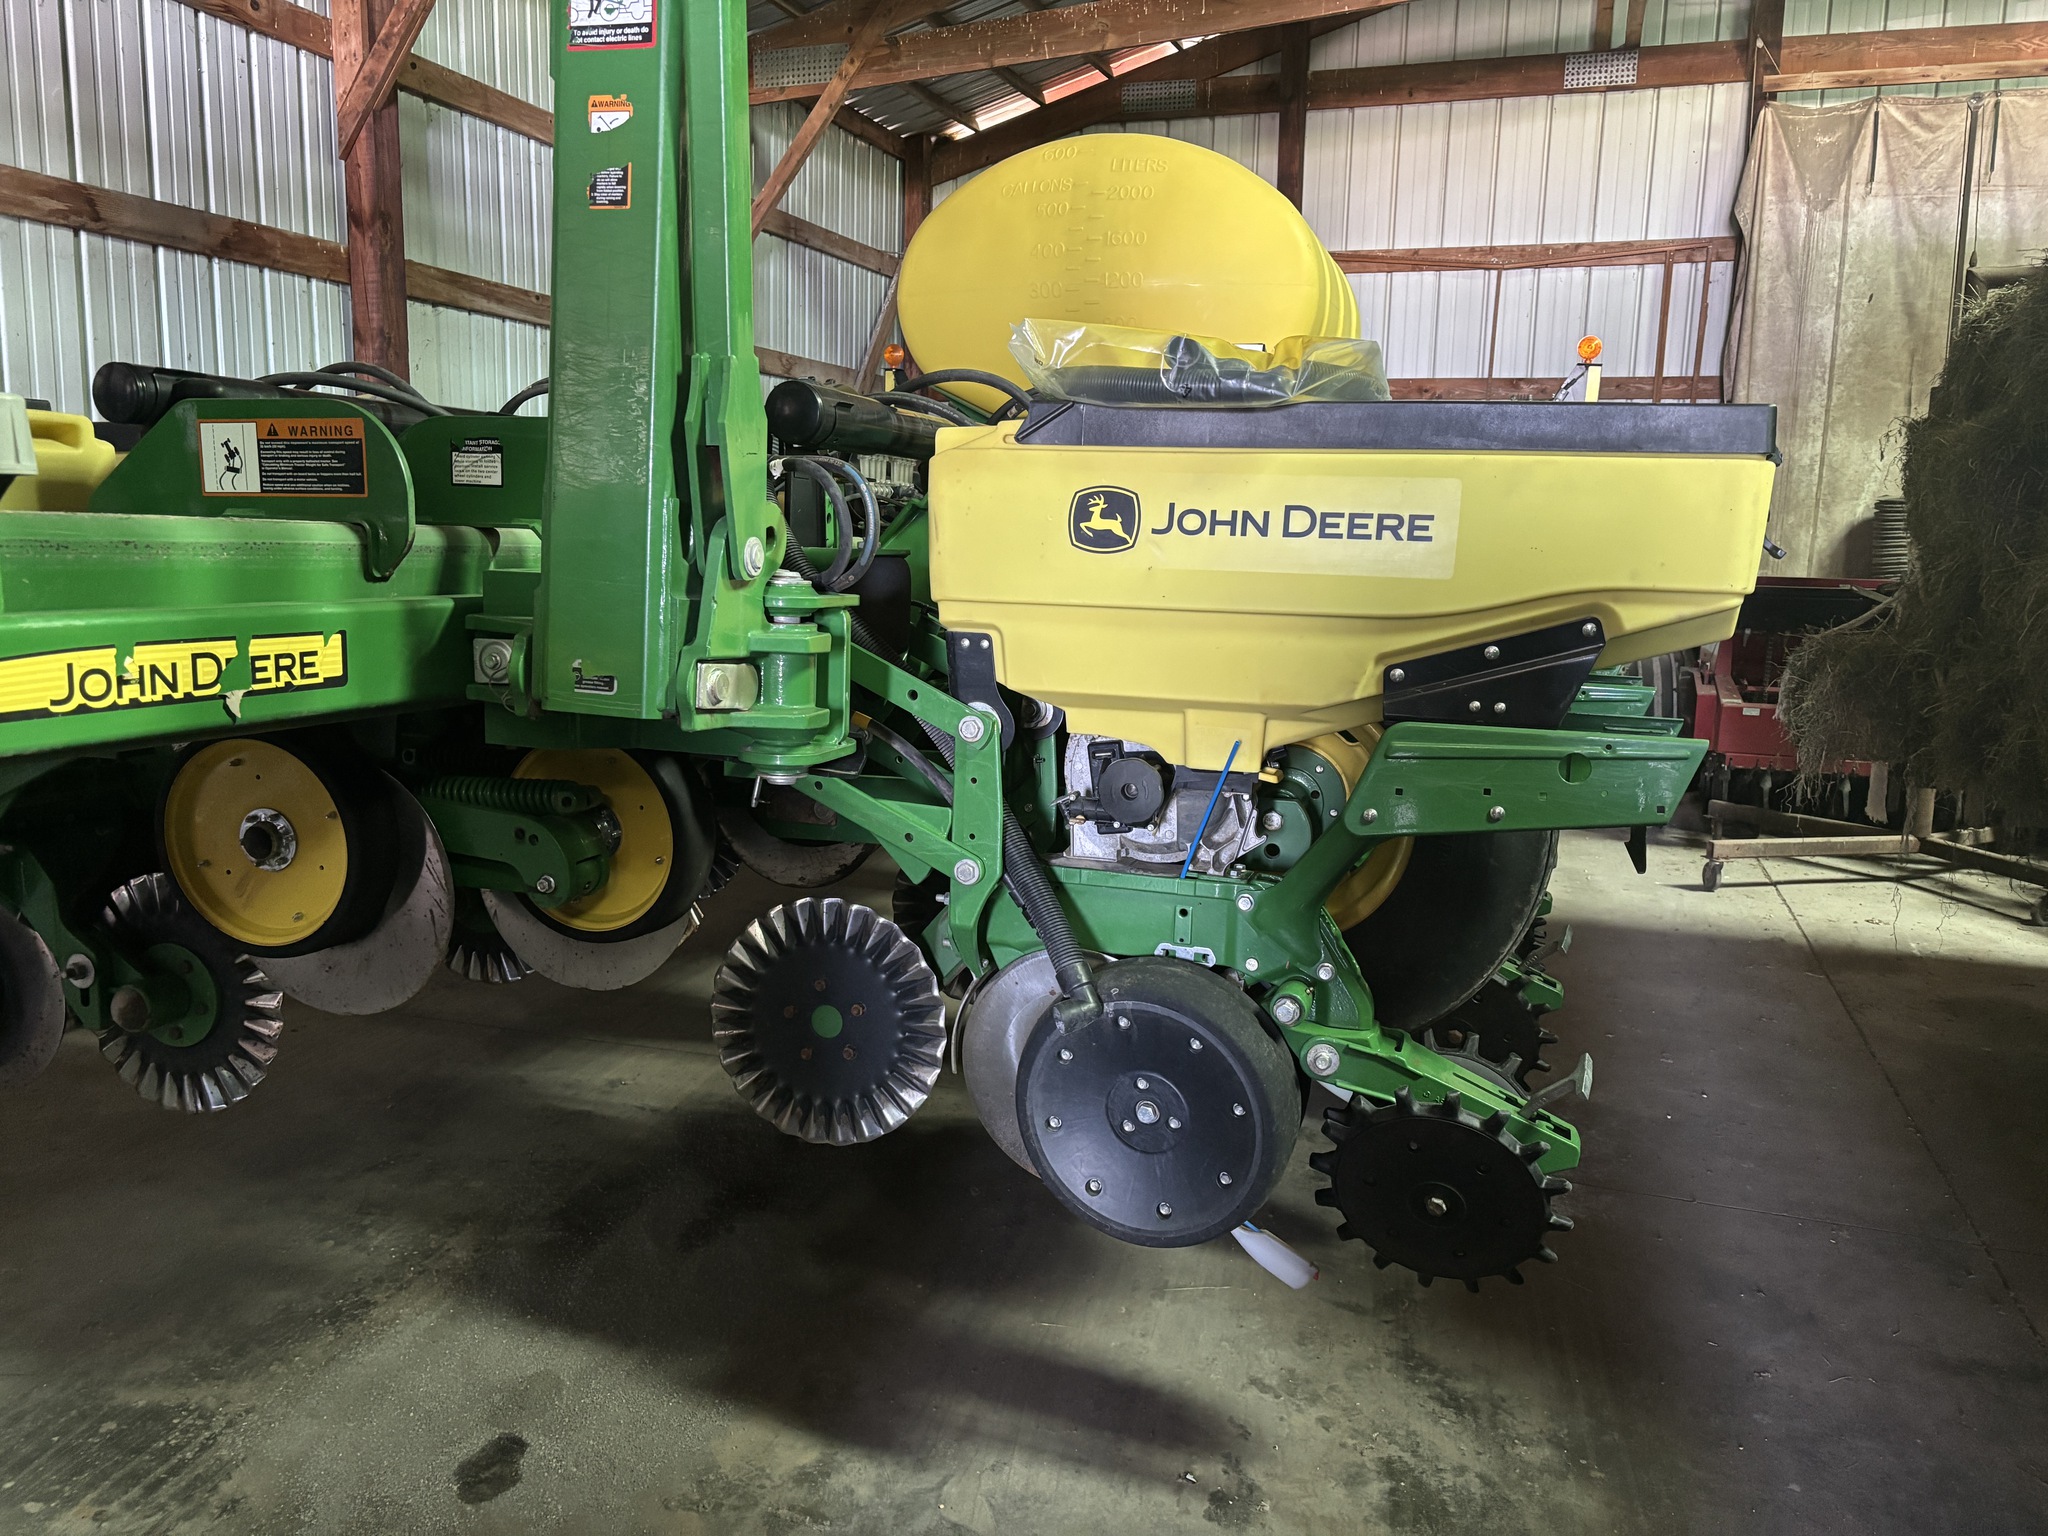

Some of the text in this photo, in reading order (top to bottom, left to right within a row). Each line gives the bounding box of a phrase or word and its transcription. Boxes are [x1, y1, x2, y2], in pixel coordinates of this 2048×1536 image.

[599, 28, 615, 36] injury
[623, 26, 640, 34] death
[605, 35, 627, 43] electric
[597, 100, 631, 108] WARNING
[1043, 145, 1078, 161] 600
[1110, 158, 1169, 173] LITERS
[1002, 177, 1074, 198] GALLONS
[1106, 185, 1155, 200] 2000
[1036, 201, 1070, 217] 500
[1106, 230, 1148, 247] 1600
[1031, 242, 1065, 259] 400
[1104, 271, 1144, 289] 1200
[1029, 281, 1063, 299] 300
[288, 425, 353, 437] WARNING
[1151, 502, 1435, 542] JOHN DEERE
[49, 651, 320, 707] JOHN DERE
